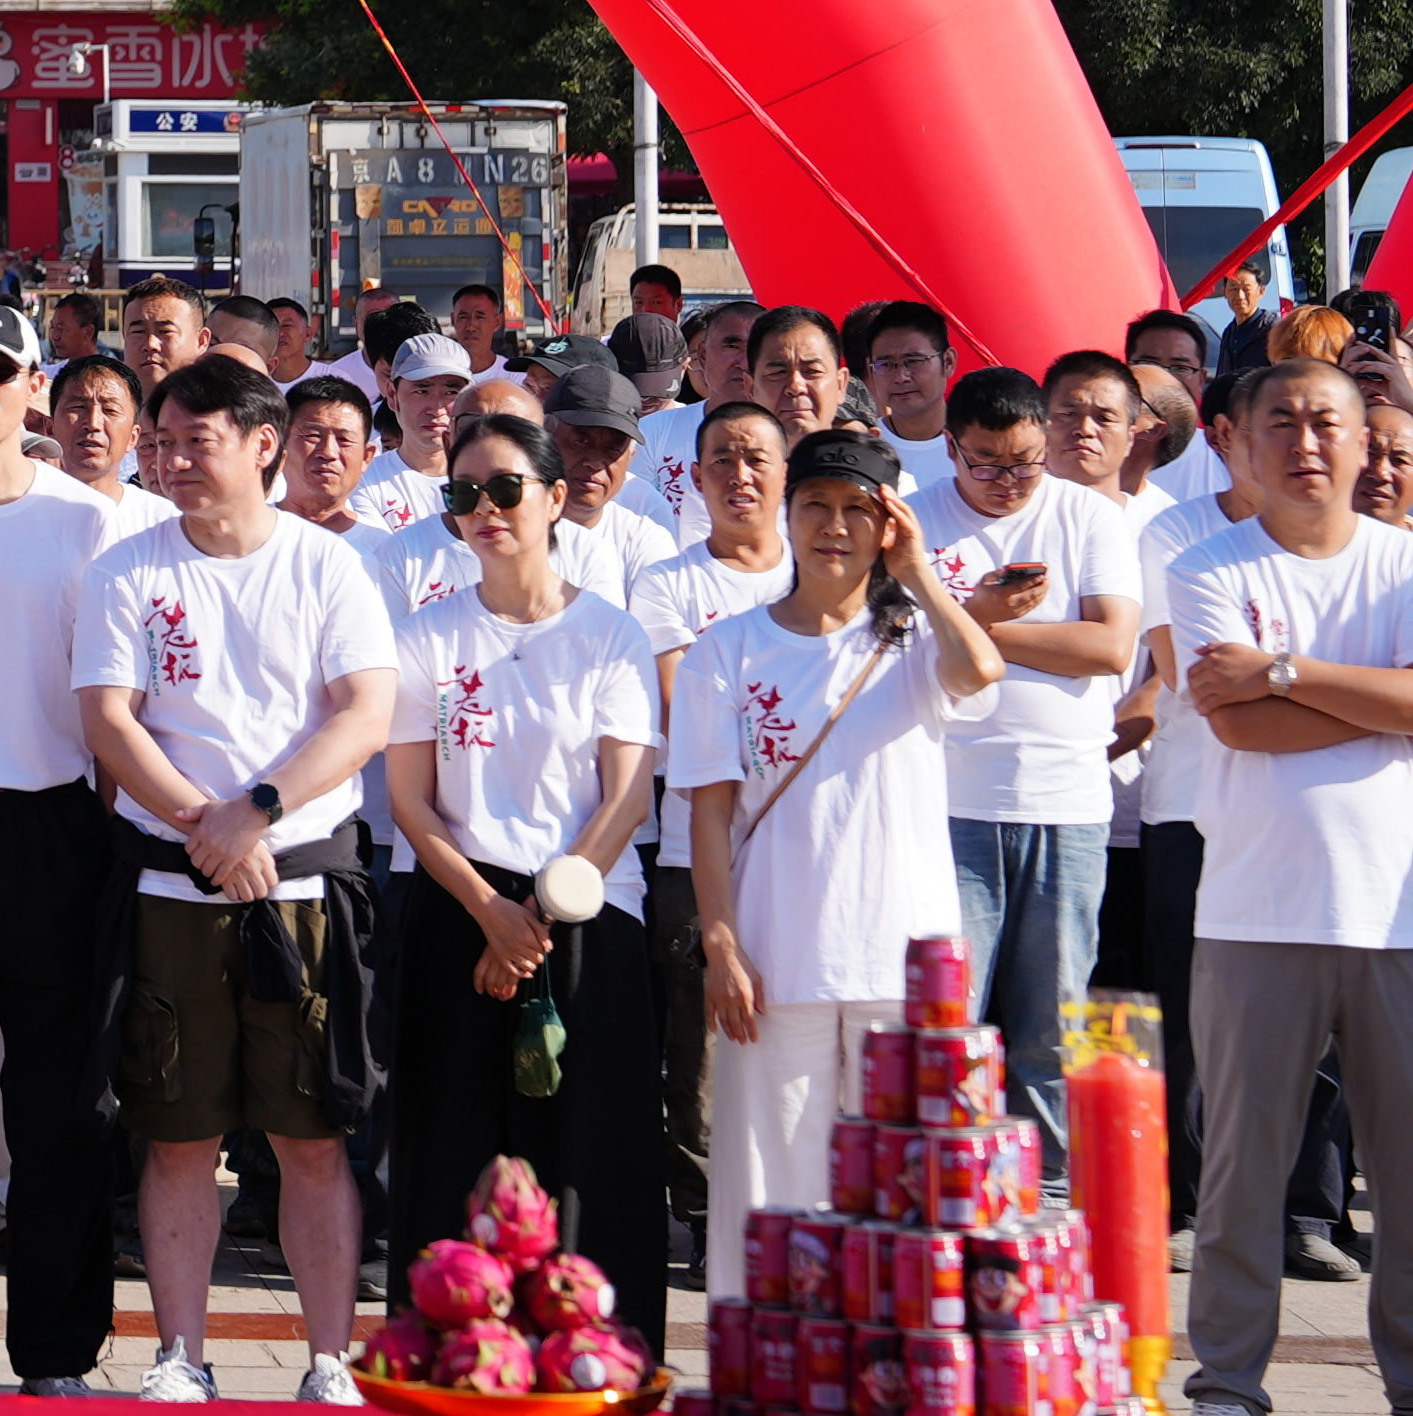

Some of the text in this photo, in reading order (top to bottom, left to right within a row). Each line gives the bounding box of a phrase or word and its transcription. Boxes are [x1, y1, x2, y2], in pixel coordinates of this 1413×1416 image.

[31, 23, 276, 88] 蜜雪冰
[156, 111, 199, 131] 公安
[438, 693, 451, 761] MATRIARCH
